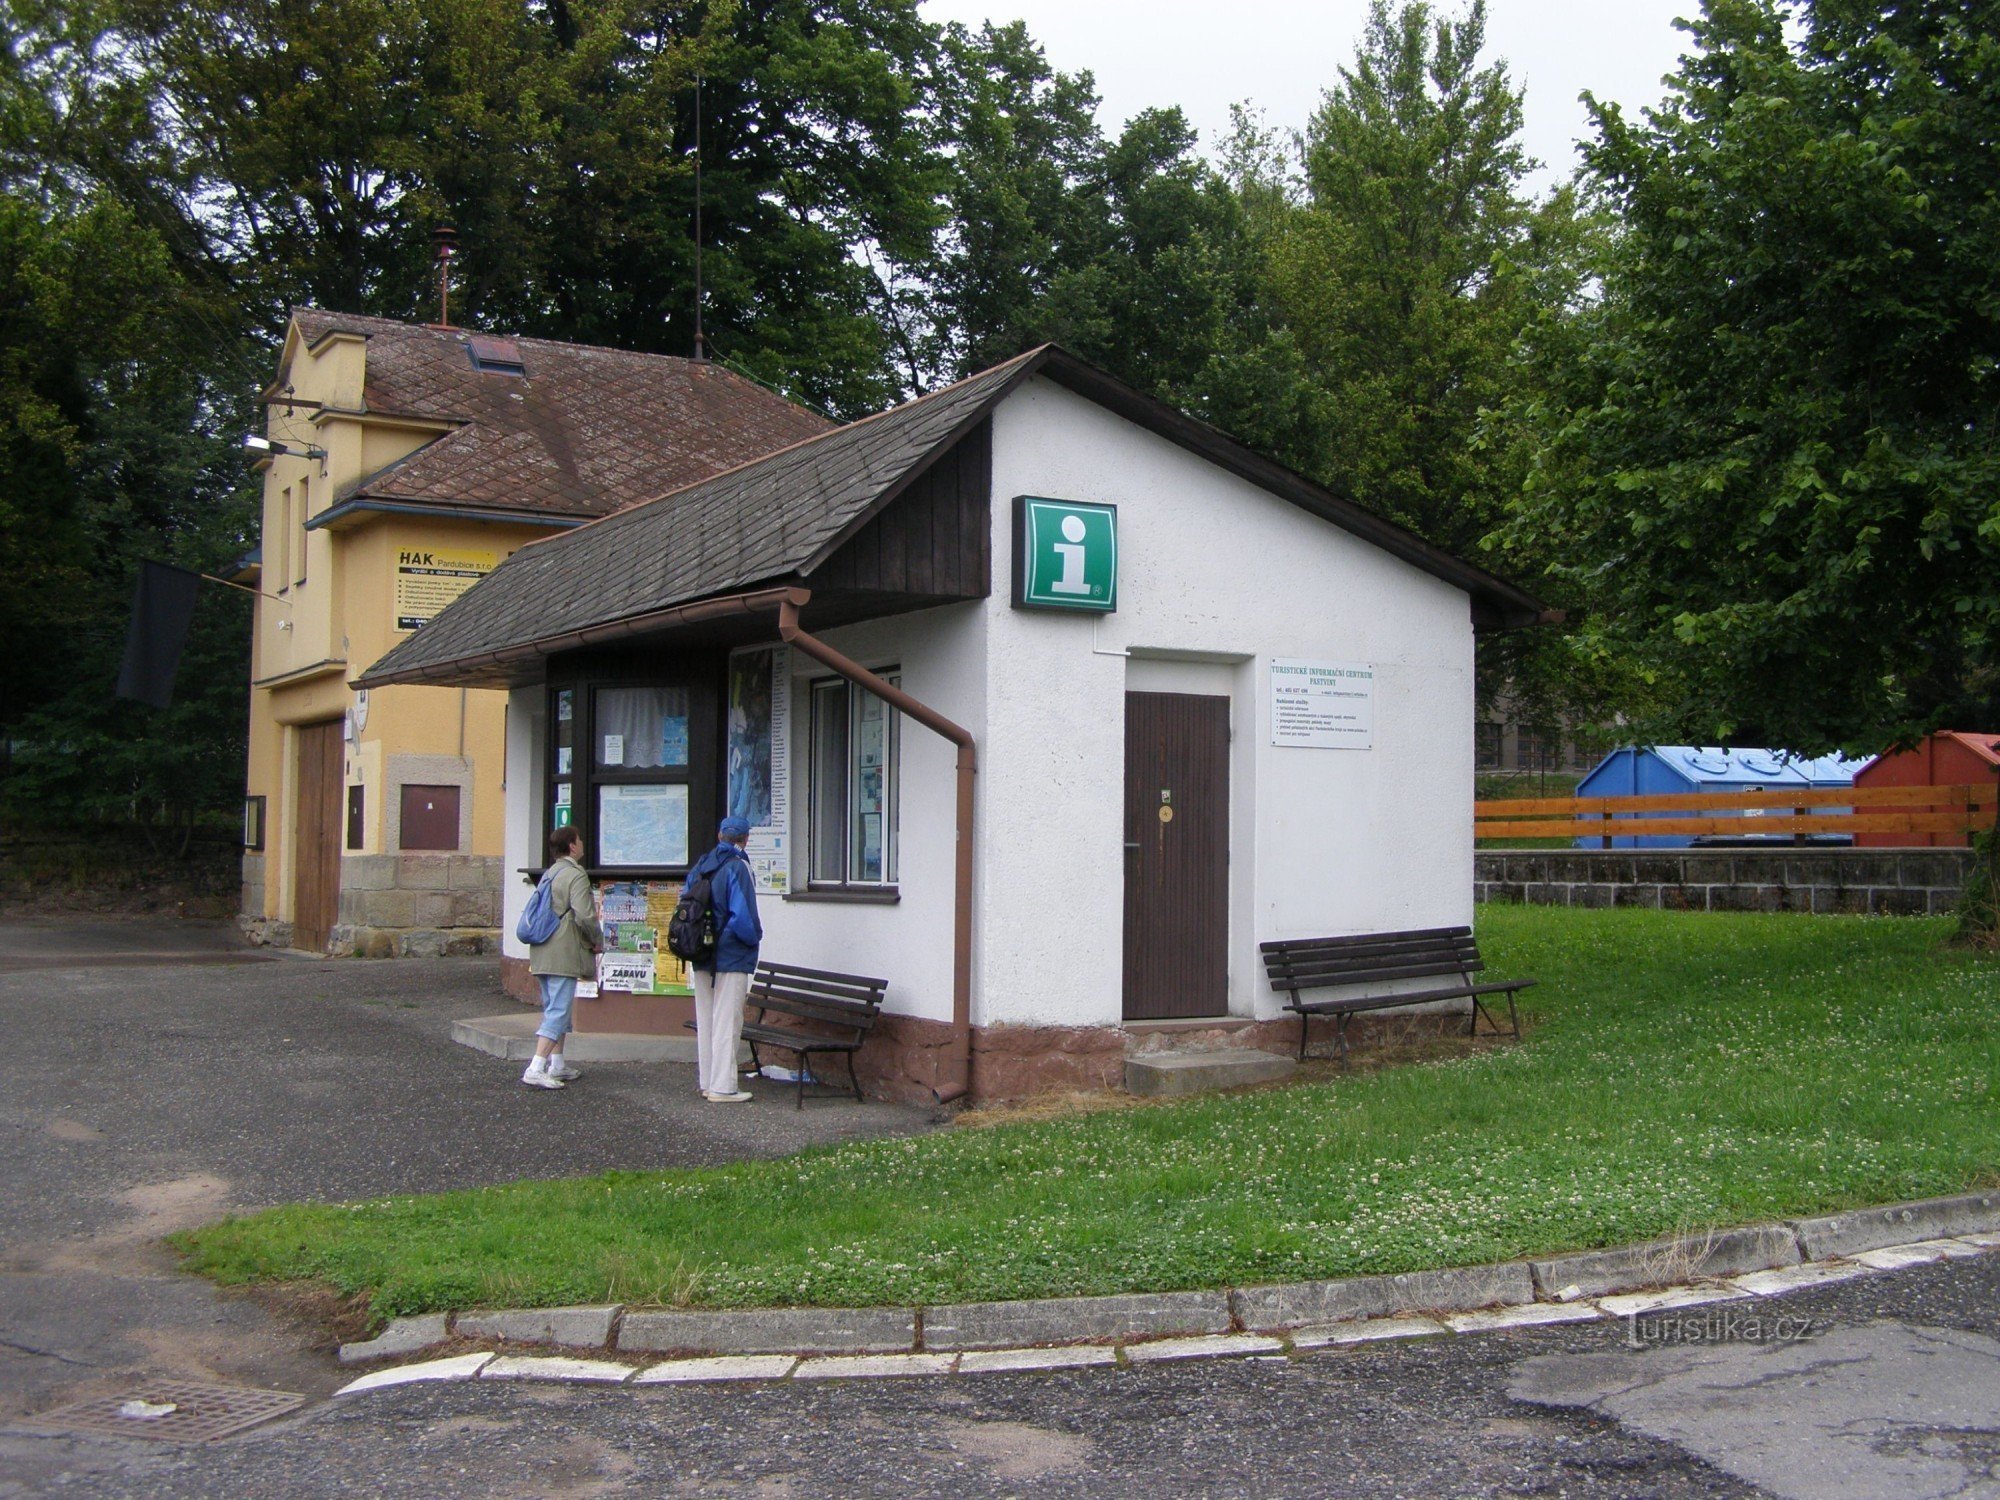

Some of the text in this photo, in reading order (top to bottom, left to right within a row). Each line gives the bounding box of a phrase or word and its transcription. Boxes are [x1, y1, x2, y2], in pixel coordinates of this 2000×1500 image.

[400, 552, 434, 566] HAK
[437, 559, 474, 569] Pardubice
[1272, 665, 1308, 675] TURISTICKÉ
[1309, 668, 1345, 677] INFORMAČNÍ
[1309, 678, 1336, 686] PASTVINY
[612, 967, 647, 979] ZÁBAVU
